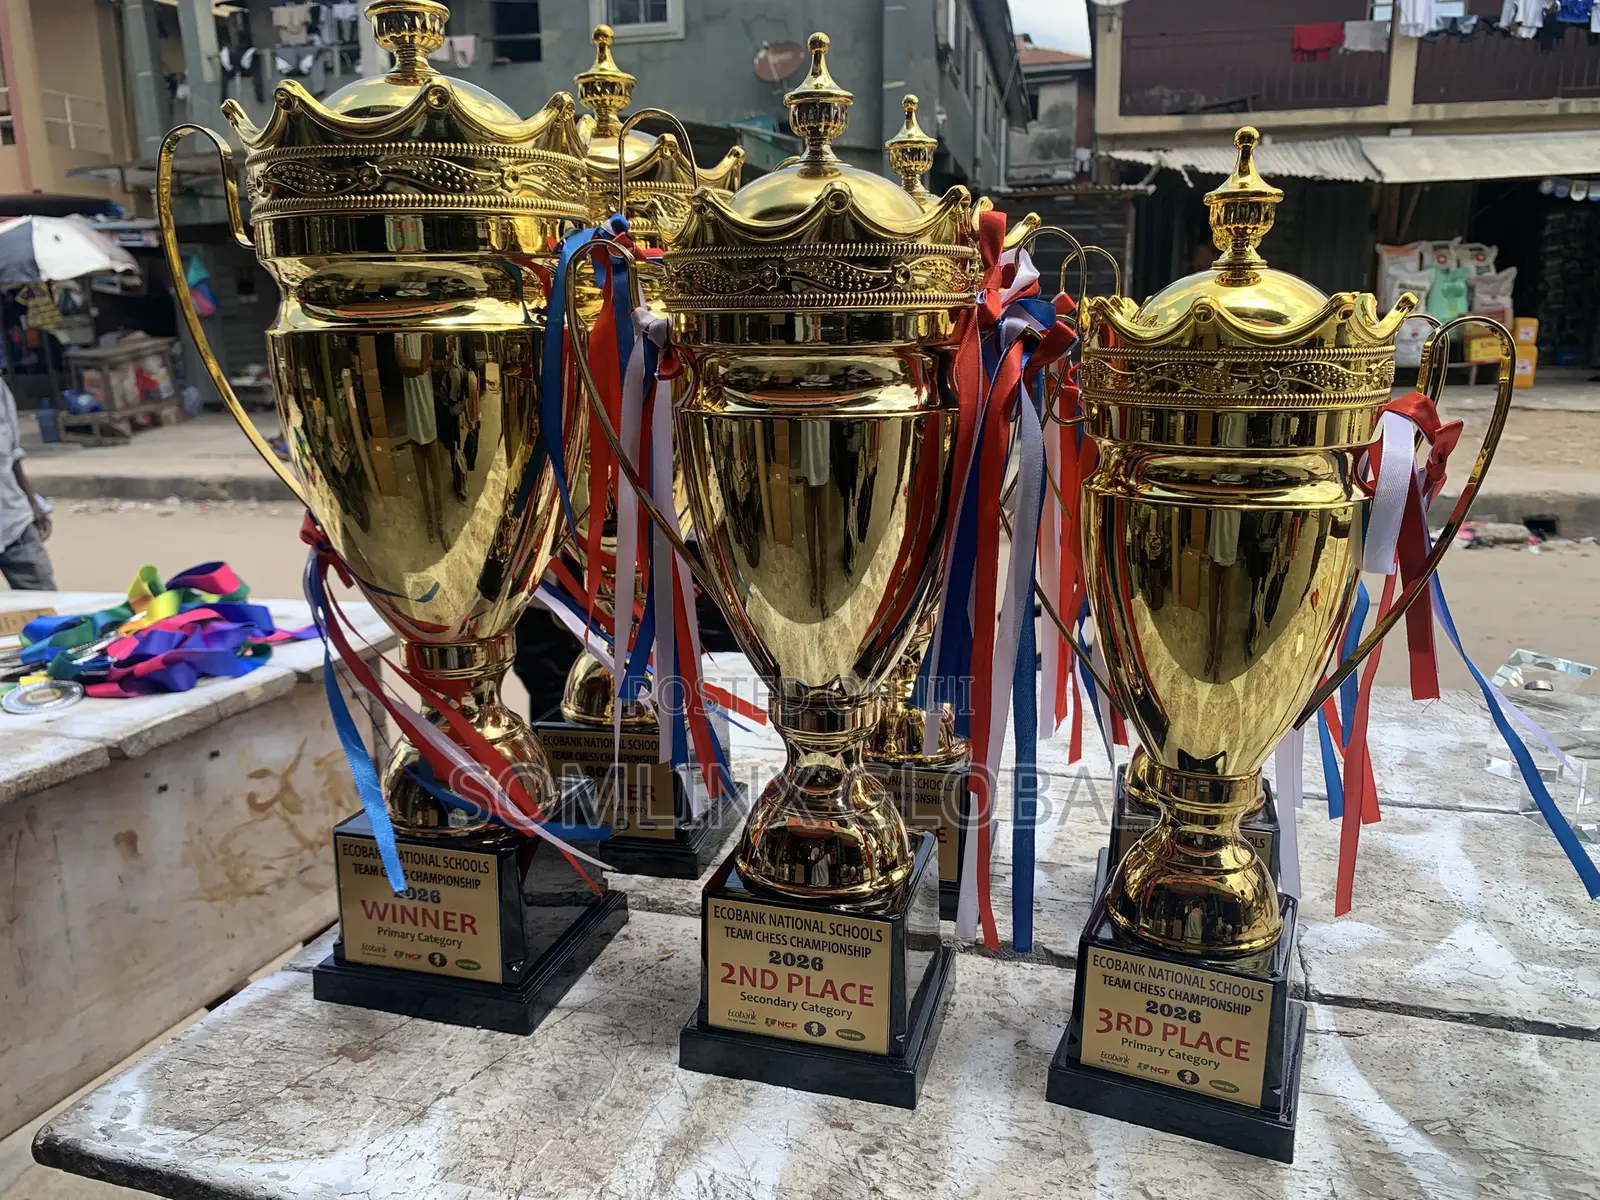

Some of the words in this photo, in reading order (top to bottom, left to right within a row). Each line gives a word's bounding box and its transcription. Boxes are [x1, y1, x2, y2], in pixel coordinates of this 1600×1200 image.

[543, 735, 581, 747] ECOBANK
[628, 739, 660, 751] SCHOO
[552, 750, 573, 760] TEAM
[575, 751, 599, 761] CHESS
[399, 850, 441, 868] ATIONAL
[443, 856, 490, 874] SCHOOLS
[352, 863, 378, 877] TEAM
[411, 870, 481, 890] CHAMPIONSHIP
[395, 887, 441, 904] 026
[360, 899, 478, 936] WINNER
[714, 905, 766, 925] ECOBANK
[769, 913, 826, 934] NATIONAL
[829, 922, 883, 943] SCHOOLS
[378, 926, 415, 943] Primary
[418, 932, 462, 950] Category
[724, 926, 753, 941] TEAM
[755, 930, 787, 946] CHESS
[790, 936, 872, 959] CHAMPIONSHIP
[768, 950, 824, 972] 2026
[720, 962, 778, 991] 2ND
[787, 973, 874, 1007] PLACE
[1093, 954, 1146, 977] ECOBANK
[1148, 966, 1206, 989] NATIONAL
[1209, 979, 1264, 1002] SCHOOLS
[740, 991, 798, 1012] Secondary
[801, 1001, 853, 1021] Category
[1102, 974, 1131, 990] TEAM
[1133, 981, 1166, 998] CHESS
[1168, 988, 1252, 1016] CHAMPIONSHIP
[727, 1008, 757, 1021] Ecobank
[777, 1020, 798, 1029] NCF
[1145, 1000, 1201, 1024] 2026
[1096, 1008, 1153, 1037] 3RD
[1162, 1022, 1250, 1062] PLACE
[1100, 1051, 1130, 1064] Ecobank
[1150, 1065, 1170, 1076] NCF
[1121, 1037, 1165, 1058] Primary
[1168, 1048, 1220, 1070] Category
